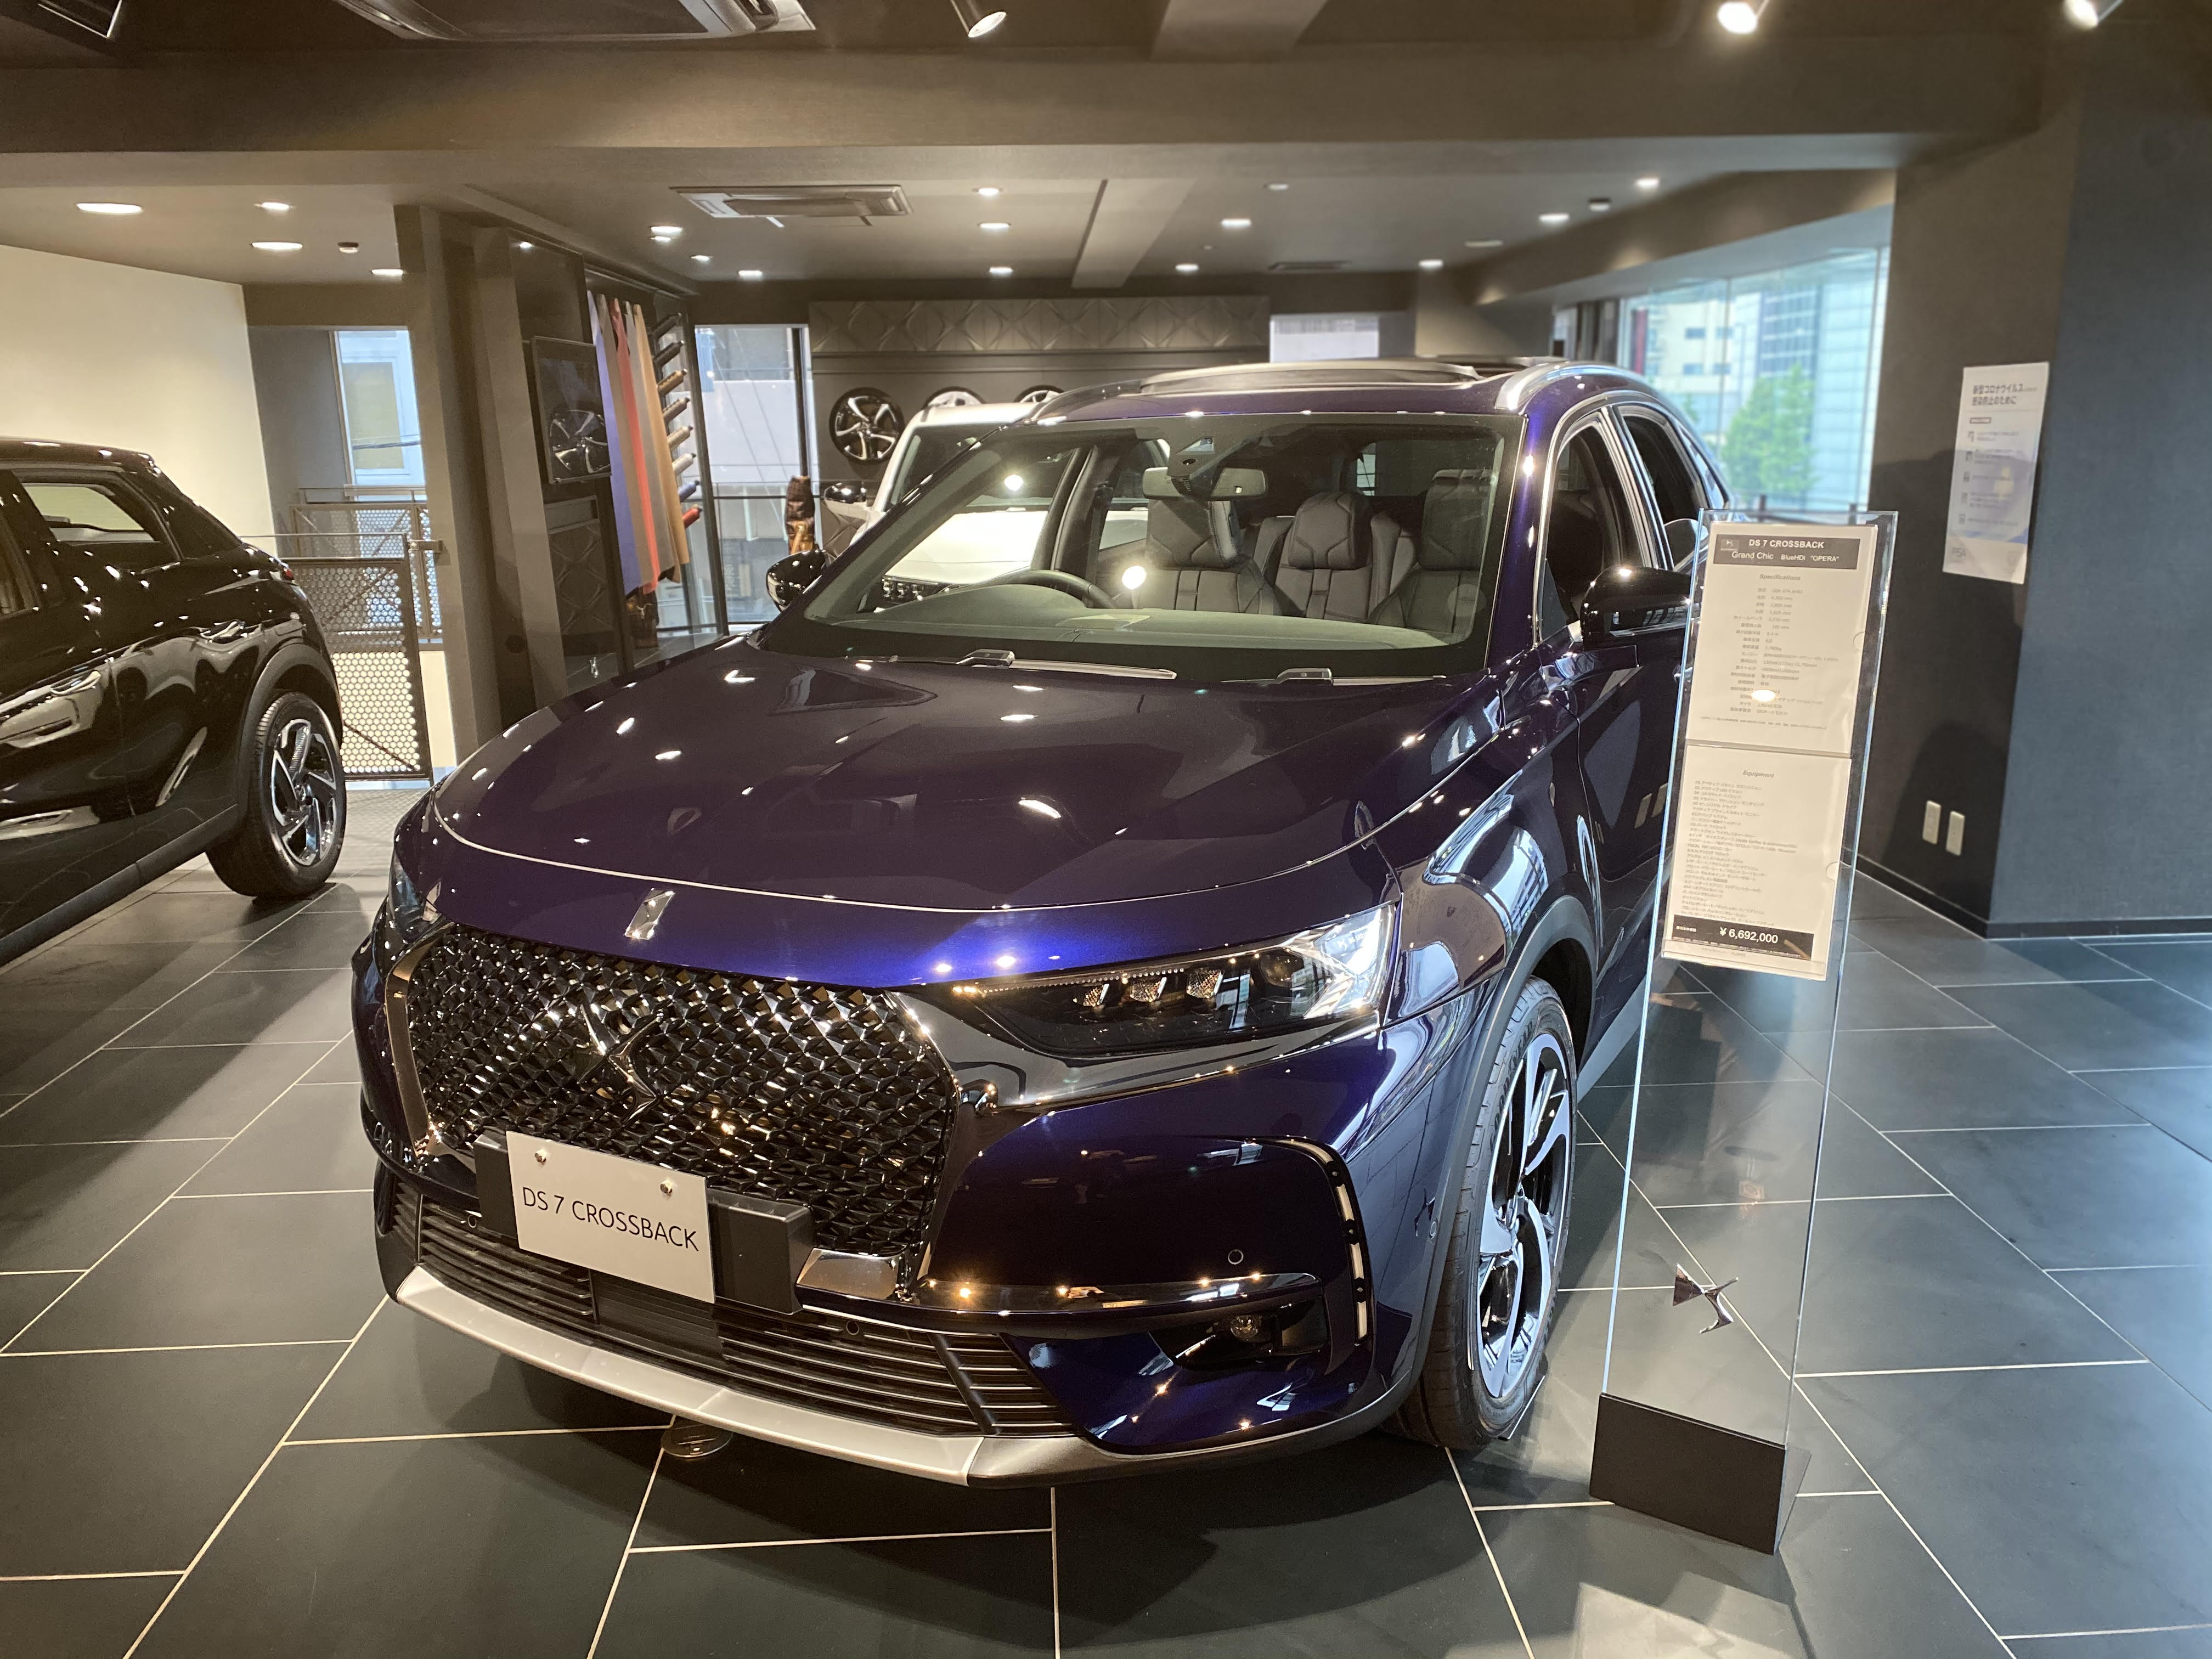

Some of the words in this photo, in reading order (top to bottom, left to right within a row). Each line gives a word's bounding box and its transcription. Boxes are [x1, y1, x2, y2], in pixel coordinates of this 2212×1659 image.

[1769, 540, 1824, 549] CROSSBACK
[1731, 551, 1755, 559] Grand
[1742, 770, 1775, 778] Equipment
[1729, 928, 1779, 944] 6,692,000
[522, 1187, 548, 1211] DS
[554, 1194, 565, 1214] 7
[572, 1200, 699, 1252] CROSSBACK
